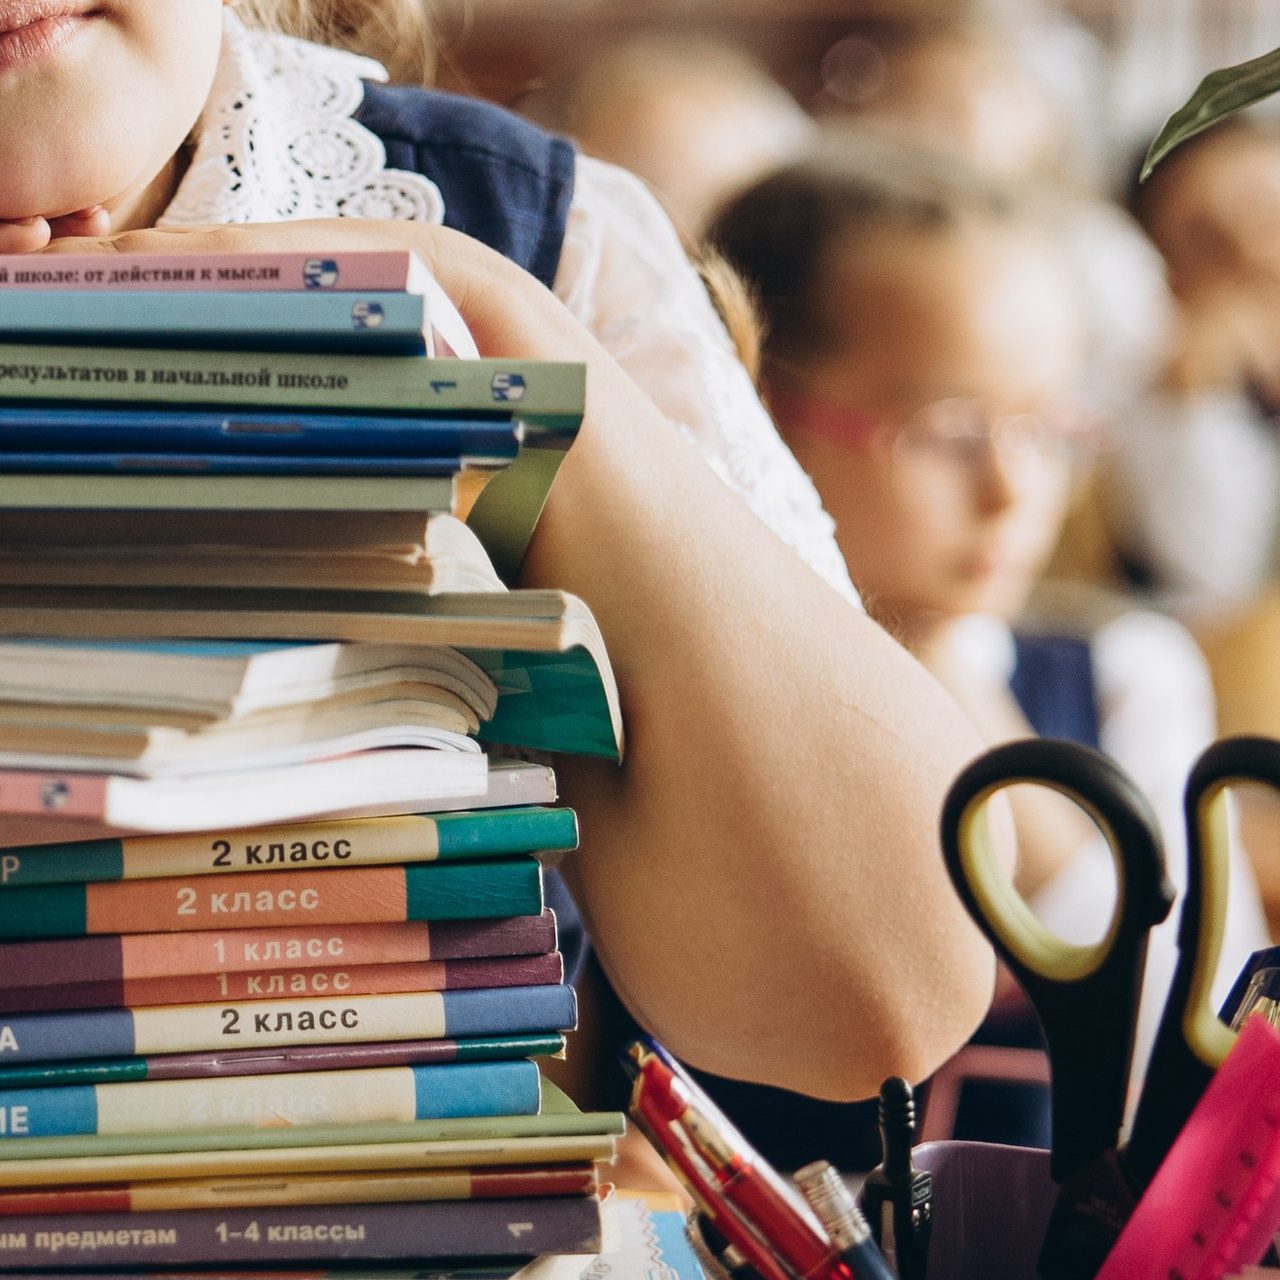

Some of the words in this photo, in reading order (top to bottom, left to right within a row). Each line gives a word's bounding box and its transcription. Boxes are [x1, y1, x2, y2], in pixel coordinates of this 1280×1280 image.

[14, 269, 79, 284] школе:
[84, 269, 103, 283] от
[108, 265, 196, 284] действия
[200, 267, 211, 281] к
[216, 266, 280, 281] мысли
[133, 368, 147, 384] в
[152, 367, 271, 389] начальной
[277, 371, 350, 390] школе
[211, 839, 232, 867] 2
[245, 838, 352, 865] класс
[176, 887, 197, 915] 2
[210, 888, 319, 914] класс
[213, 939, 225, 963] 1
[243, 936, 345, 961] класс
[216, 971, 228, 996] 1
[247, 971, 351, 994] класс
[221, 1008, 241, 1035] 2
[254, 1008, 359, 1033] класс
[34, 1227, 178, 1252] предметам
[267, 1223, 366, 1242] классы
